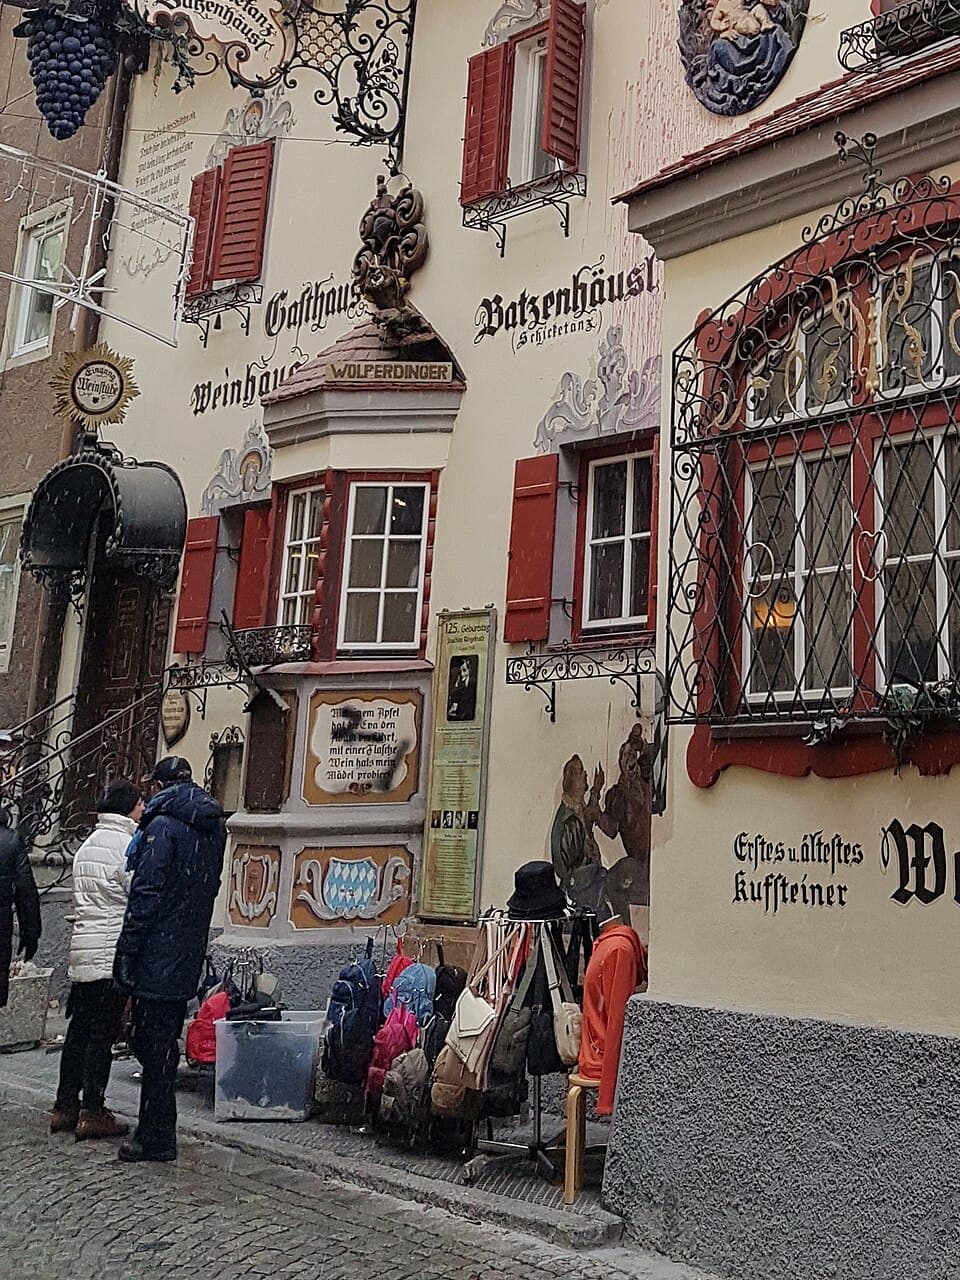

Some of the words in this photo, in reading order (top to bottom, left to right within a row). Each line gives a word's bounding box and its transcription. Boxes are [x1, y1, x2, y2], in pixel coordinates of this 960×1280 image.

[264, 274, 363, 337] Gasthaus
[474, 254, 660, 344] Batzenhäusl
[330, 363, 449, 380] WOLPERDINGER
[380, 721, 396, 730] den
[329, 745, 344, 756] mit
[345, 745, 366, 755] einer
[328, 757, 354, 767] Wein
[734, 832, 786, 870] Erstes
[788, 847, 800, 863] u.
